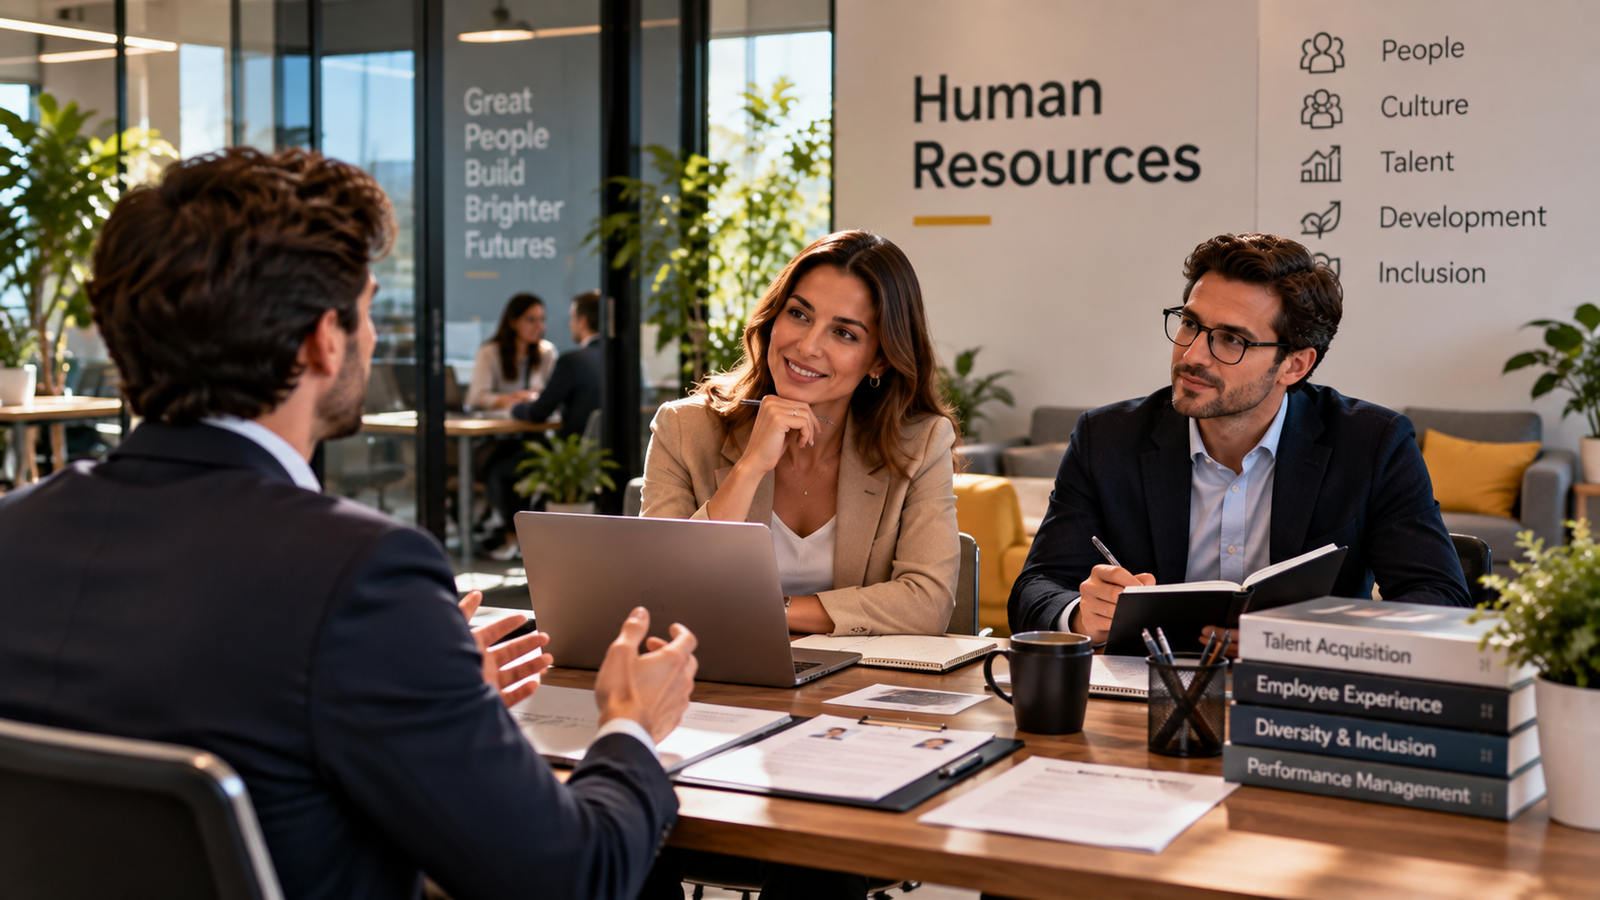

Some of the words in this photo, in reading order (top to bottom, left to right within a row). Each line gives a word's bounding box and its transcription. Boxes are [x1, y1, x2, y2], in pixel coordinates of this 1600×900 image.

[1382, 36, 1465, 66] People
[464, 86, 532, 116] Great
[914, 74, 1103, 123] Human
[1381, 93, 1469, 118] Culture
[464, 121, 550, 156] People
[464, 158, 525, 187] Build
[914, 140, 1201, 190] Resources
[1381, 148, 1455, 174] Talent
[464, 193, 564, 229] Brighter
[1379, 204, 1548, 233] Development
[464, 231, 556, 260] Futures
[1379, 260, 1486, 285] Inclusion
[1263, 631, 1311, 653] Talent
[1316, 637, 1412, 665] Acquisition
[1256, 674, 1339, 703] Employee
[1344, 685, 1443, 715] Experience
[1255, 717, 1332, 747] Diversity
[1336, 728, 1351, 747] &
[1356, 729, 1436, 758] Inclusion
[1247, 757, 1351, 788] Performance
[1356, 772, 1471, 805] Management
